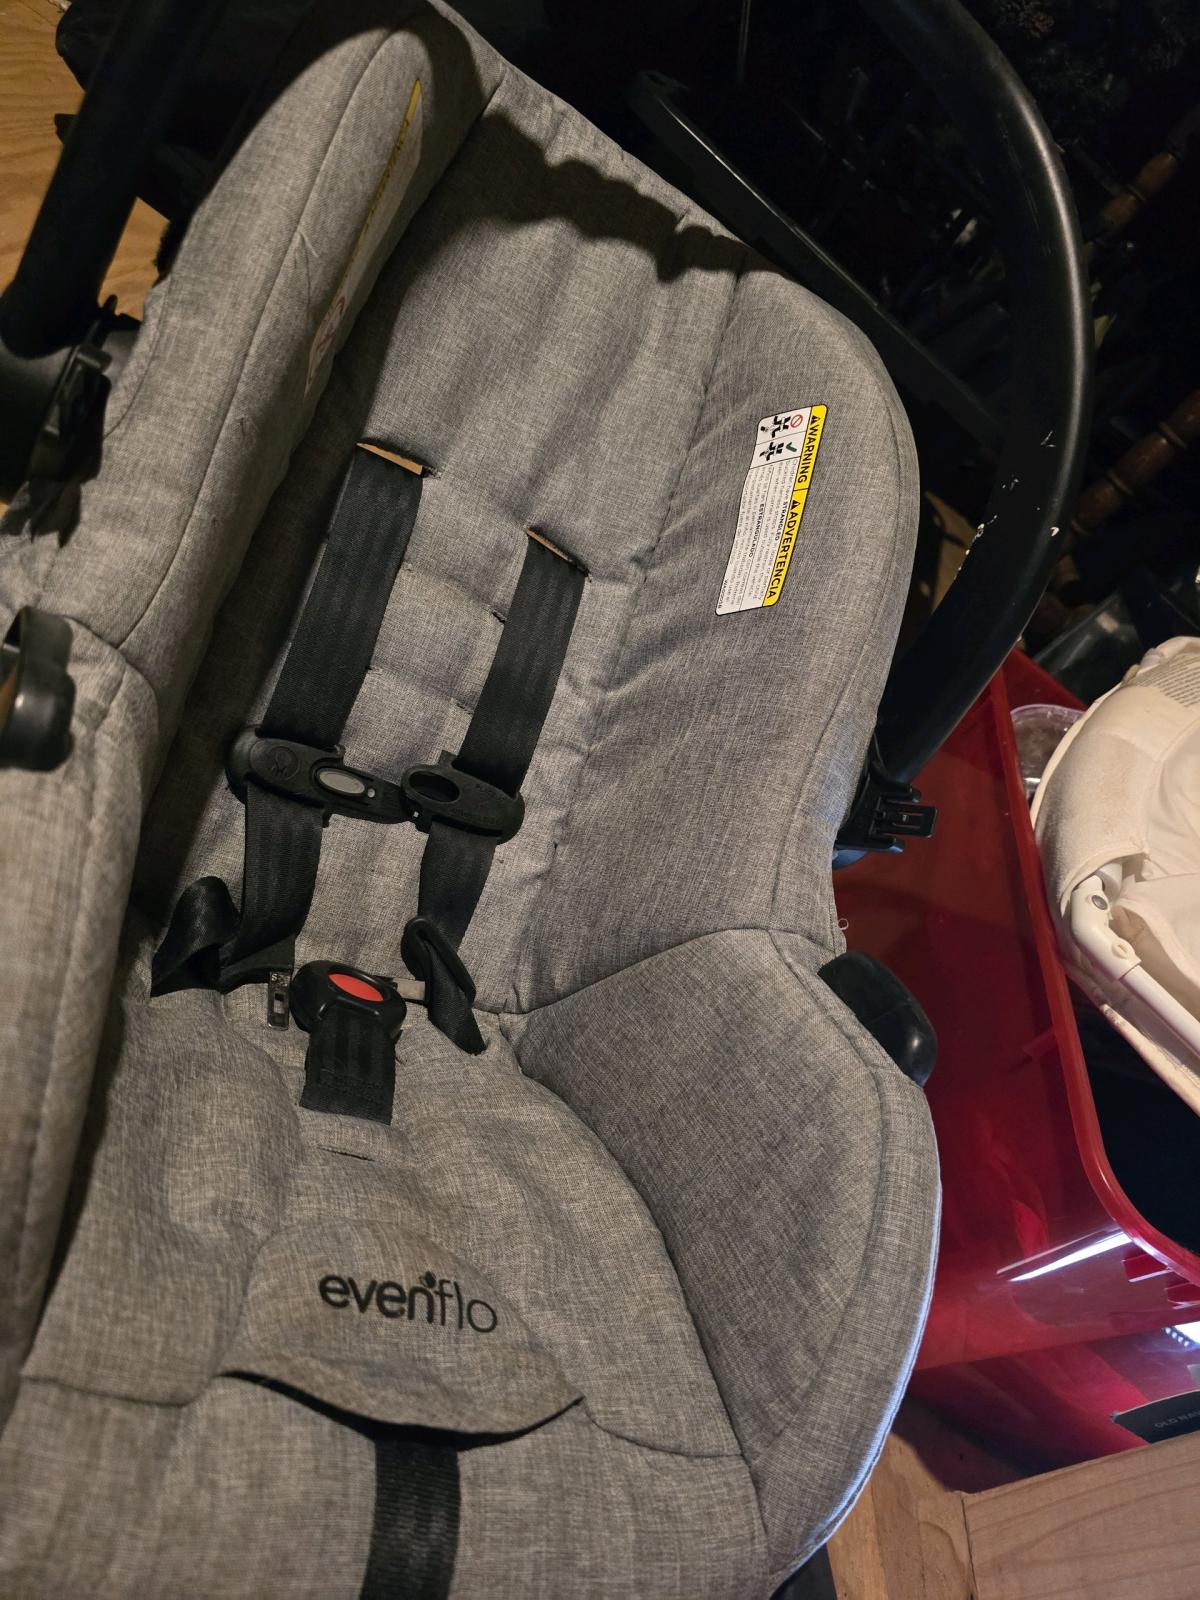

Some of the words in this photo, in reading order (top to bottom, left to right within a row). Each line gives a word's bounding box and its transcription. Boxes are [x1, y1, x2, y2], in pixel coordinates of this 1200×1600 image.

[797, 425, 818, 483] WARNING
[747, 503, 765, 557] ESTRANGULADO
[774, 501, 788, 540] STRANGLED
[766, 510, 799, 598] ADVERTENCIA
[319, 1271, 497, 1333] evenflo
